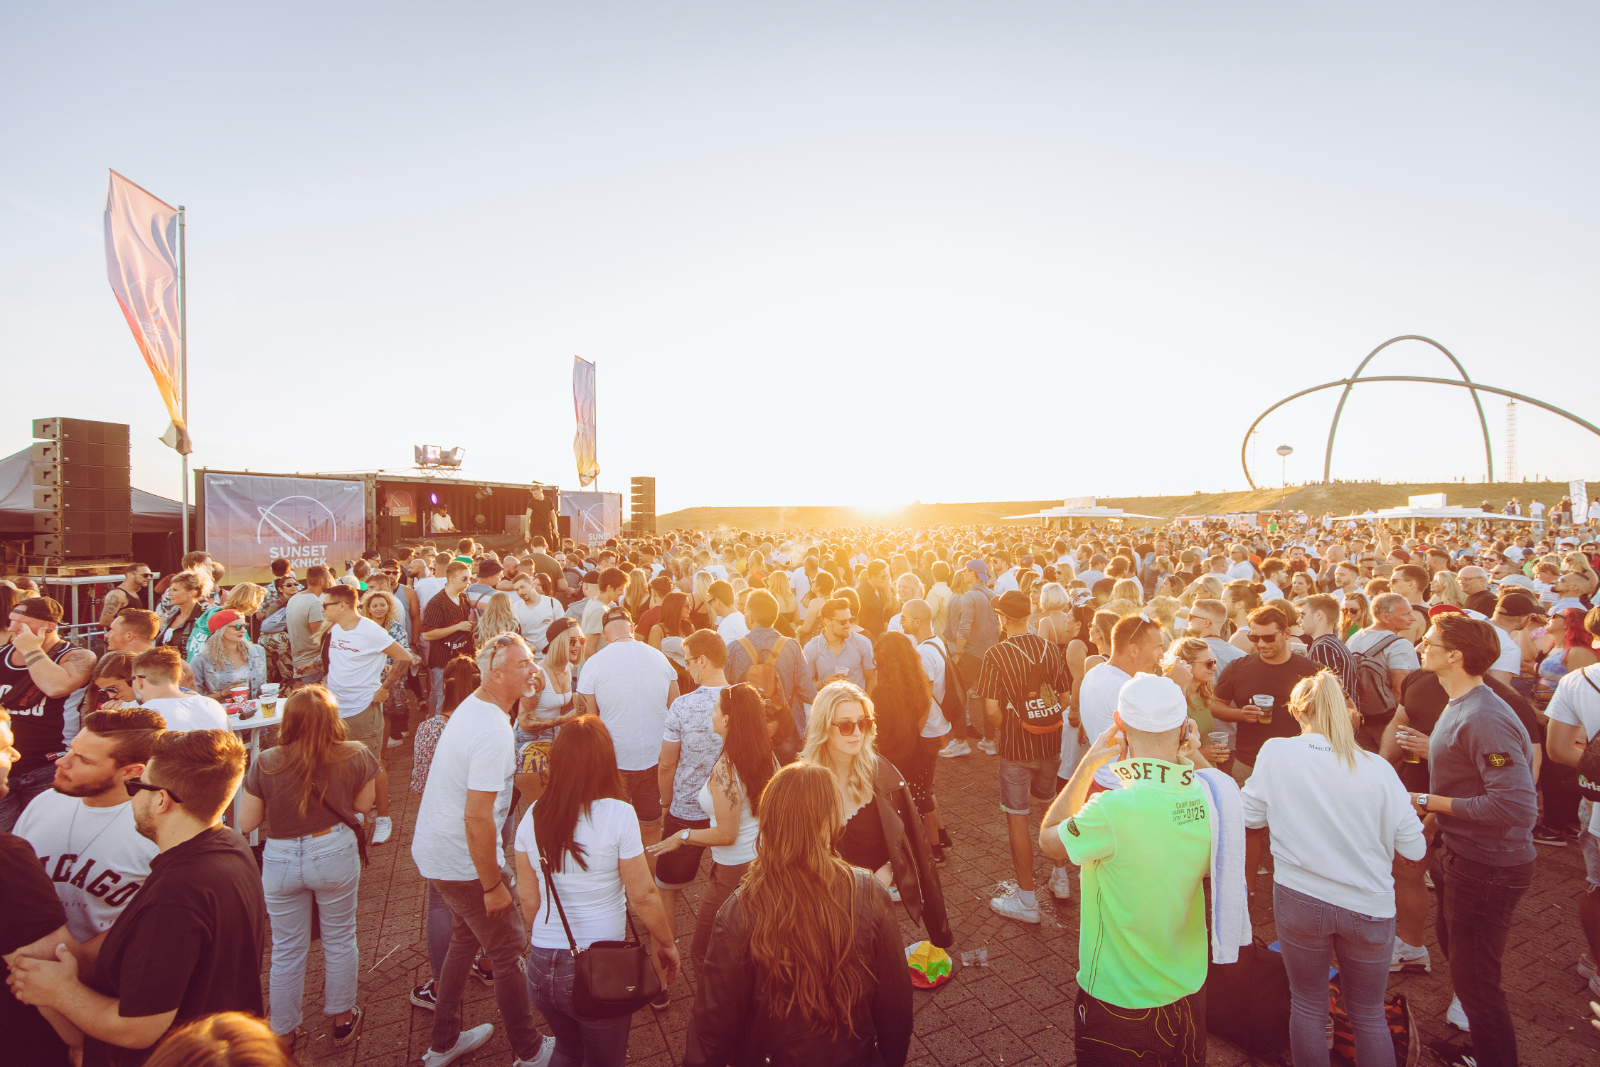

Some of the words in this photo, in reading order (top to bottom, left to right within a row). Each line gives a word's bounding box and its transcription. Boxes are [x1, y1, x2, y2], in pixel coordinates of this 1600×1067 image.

[269, 545, 328, 559] SUNSET
[269, 557, 328, 570] KNICK
[1025, 698, 1046, 711] ICE
[1186, 804, 1206, 820] 0125
[39, 853, 141, 908] CAGO
